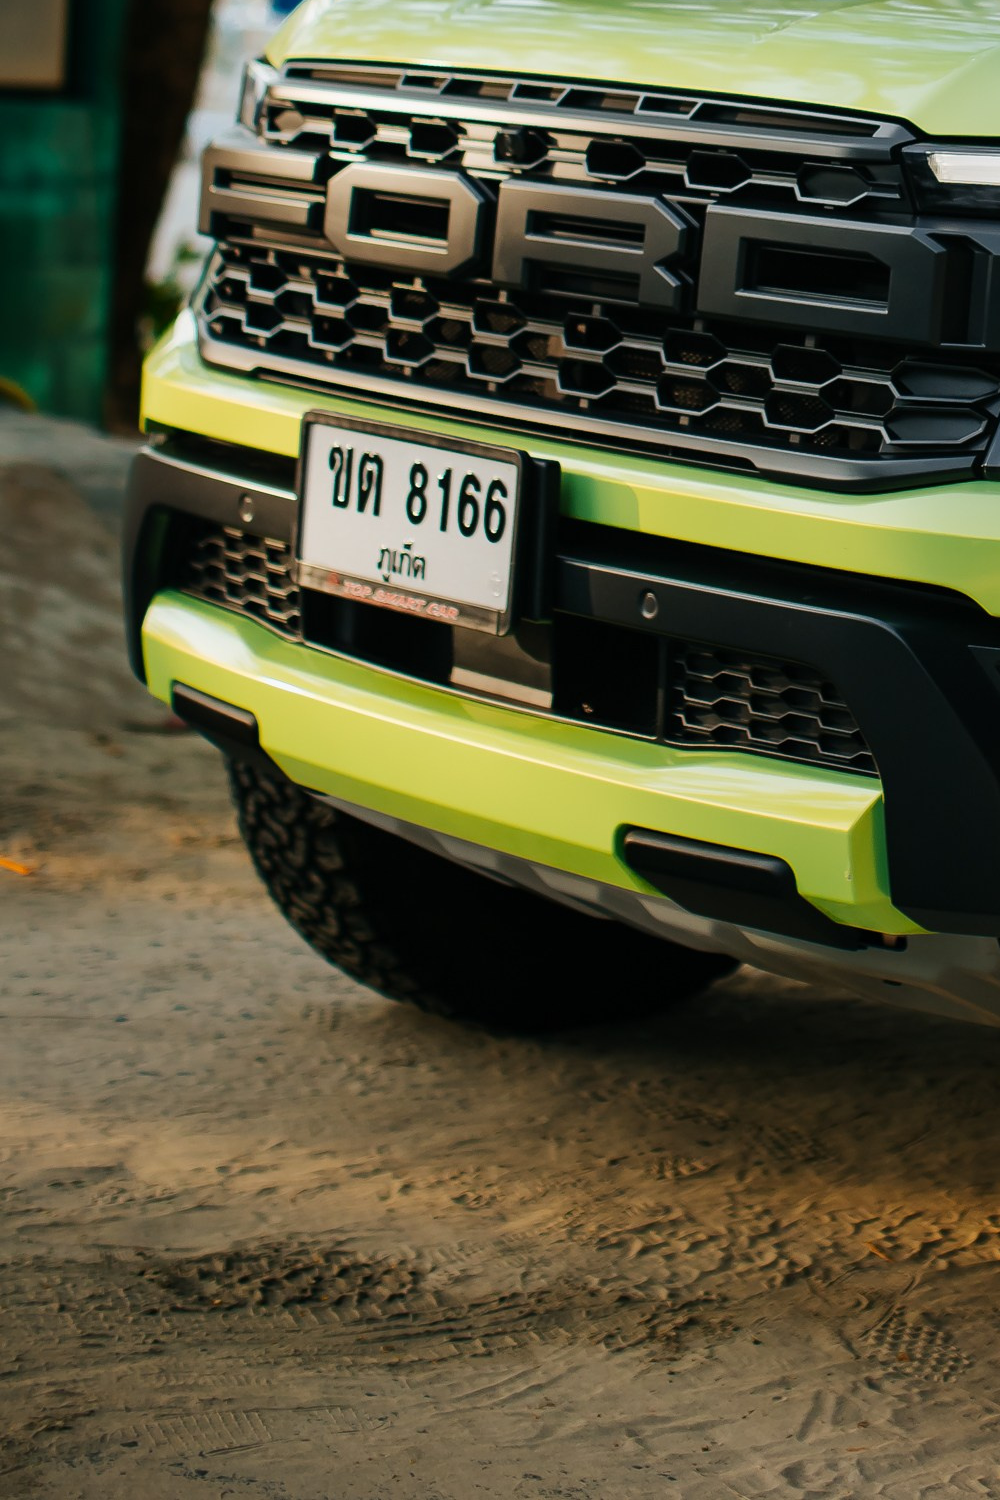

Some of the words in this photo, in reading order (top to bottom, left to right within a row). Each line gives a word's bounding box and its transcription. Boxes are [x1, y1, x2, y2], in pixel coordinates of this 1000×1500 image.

[200, 134, 948, 346] FORD
[406, 459, 508, 544] 8166
[376, 541, 427, 583] ภูเก็ต
[343, 579, 373, 599] TOP
[426, 602, 460, 620] CAR
